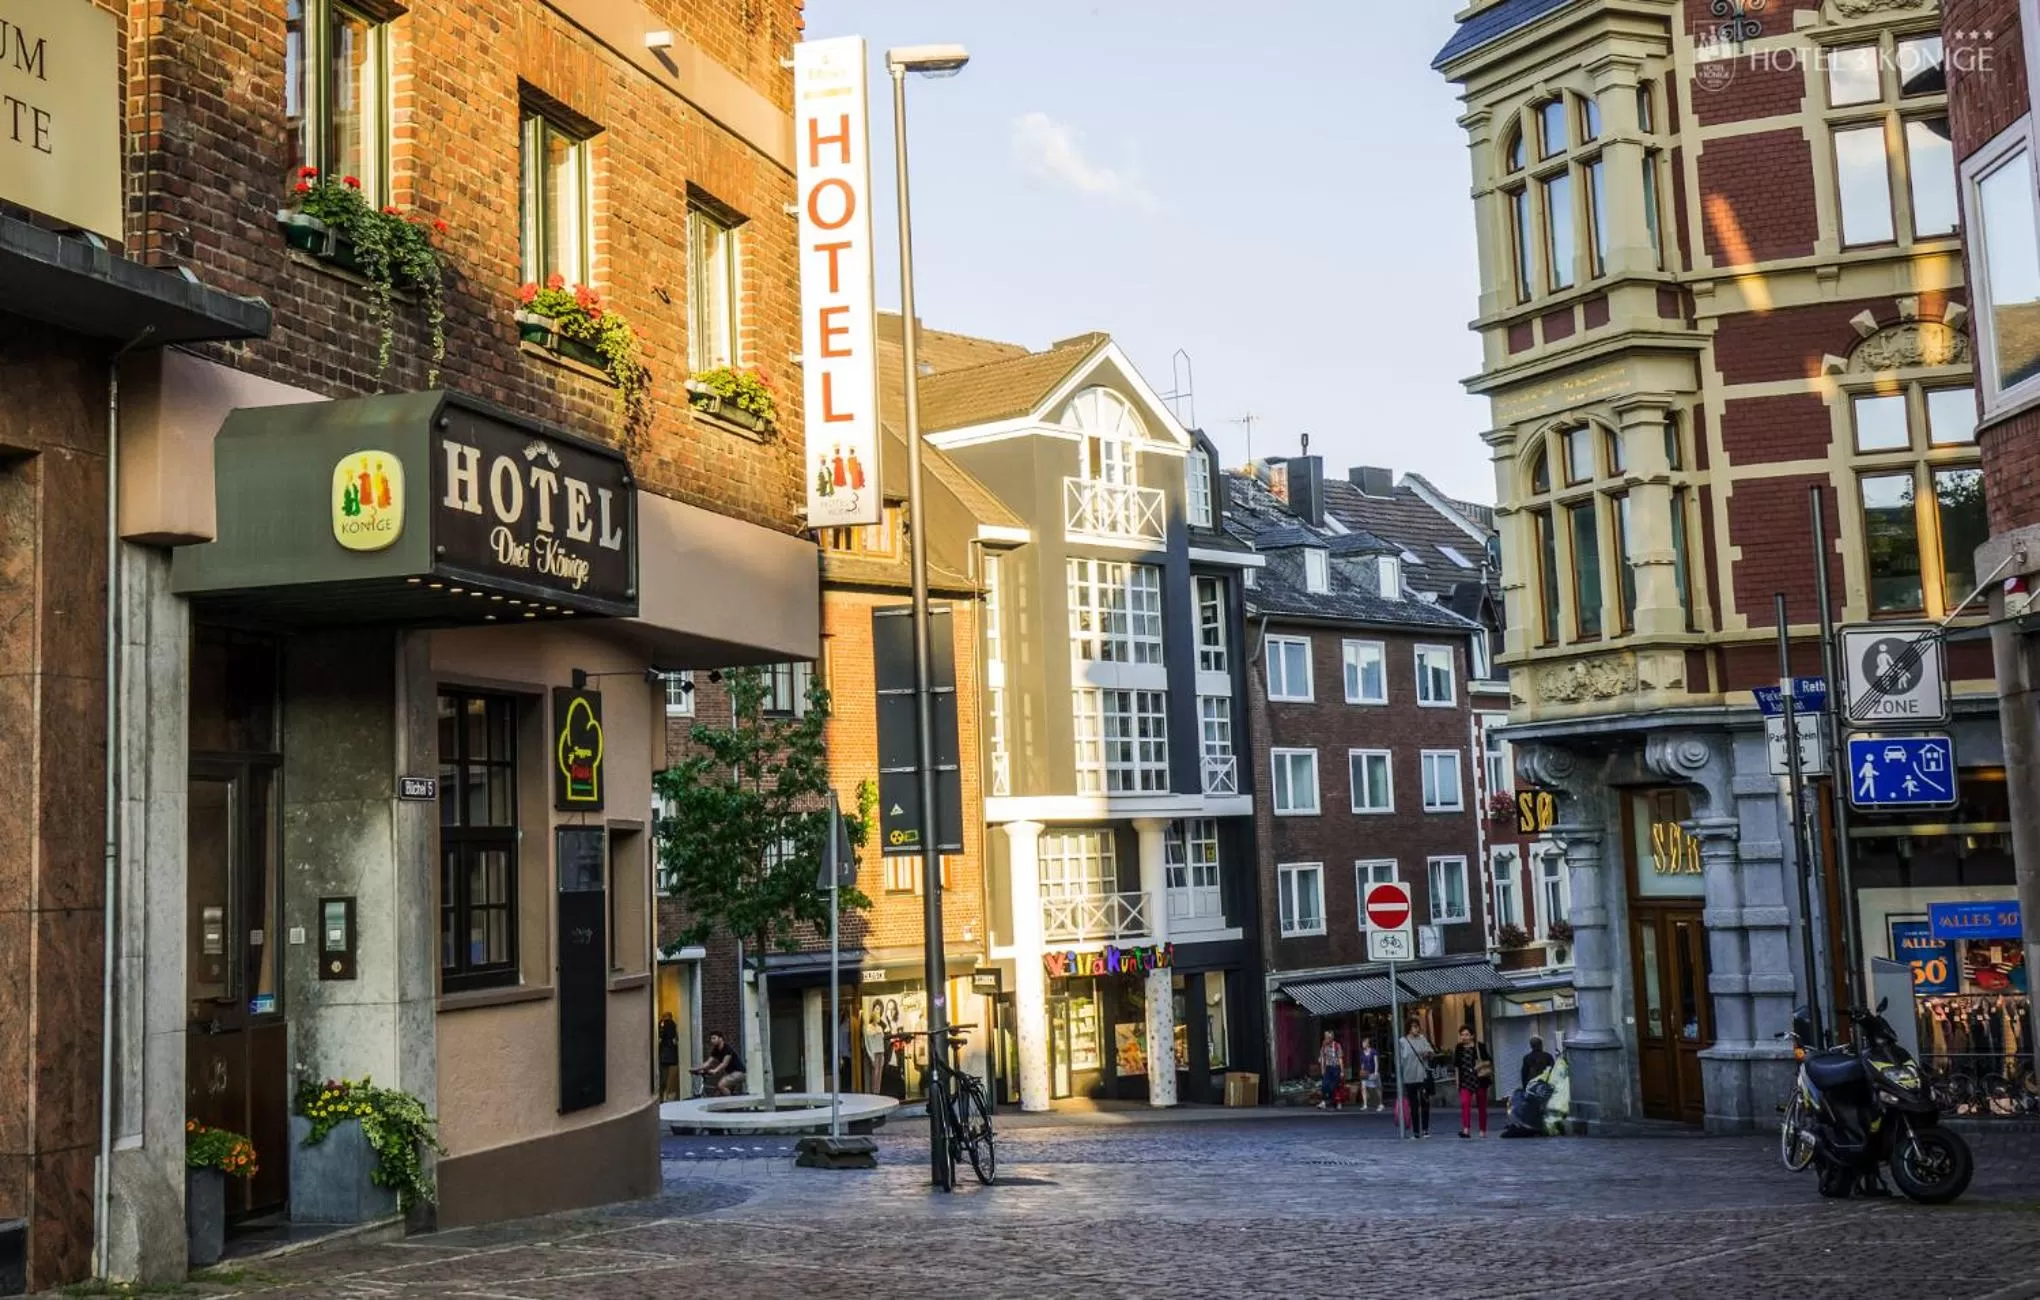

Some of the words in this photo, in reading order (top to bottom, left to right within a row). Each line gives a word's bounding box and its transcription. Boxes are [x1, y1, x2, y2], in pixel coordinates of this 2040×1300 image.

[4, 95, 52, 154] TE
[807, 113, 855, 423] HOTEL
[443, 440, 623, 551] HOTEL
[490, 526, 530, 568] Drei
[534, 534, 590, 590] Könige
[1874, 700, 1920, 714] ZONE
[427, 781, 434, 796] 5
[1938, 914, 1992, 927] ALLES
